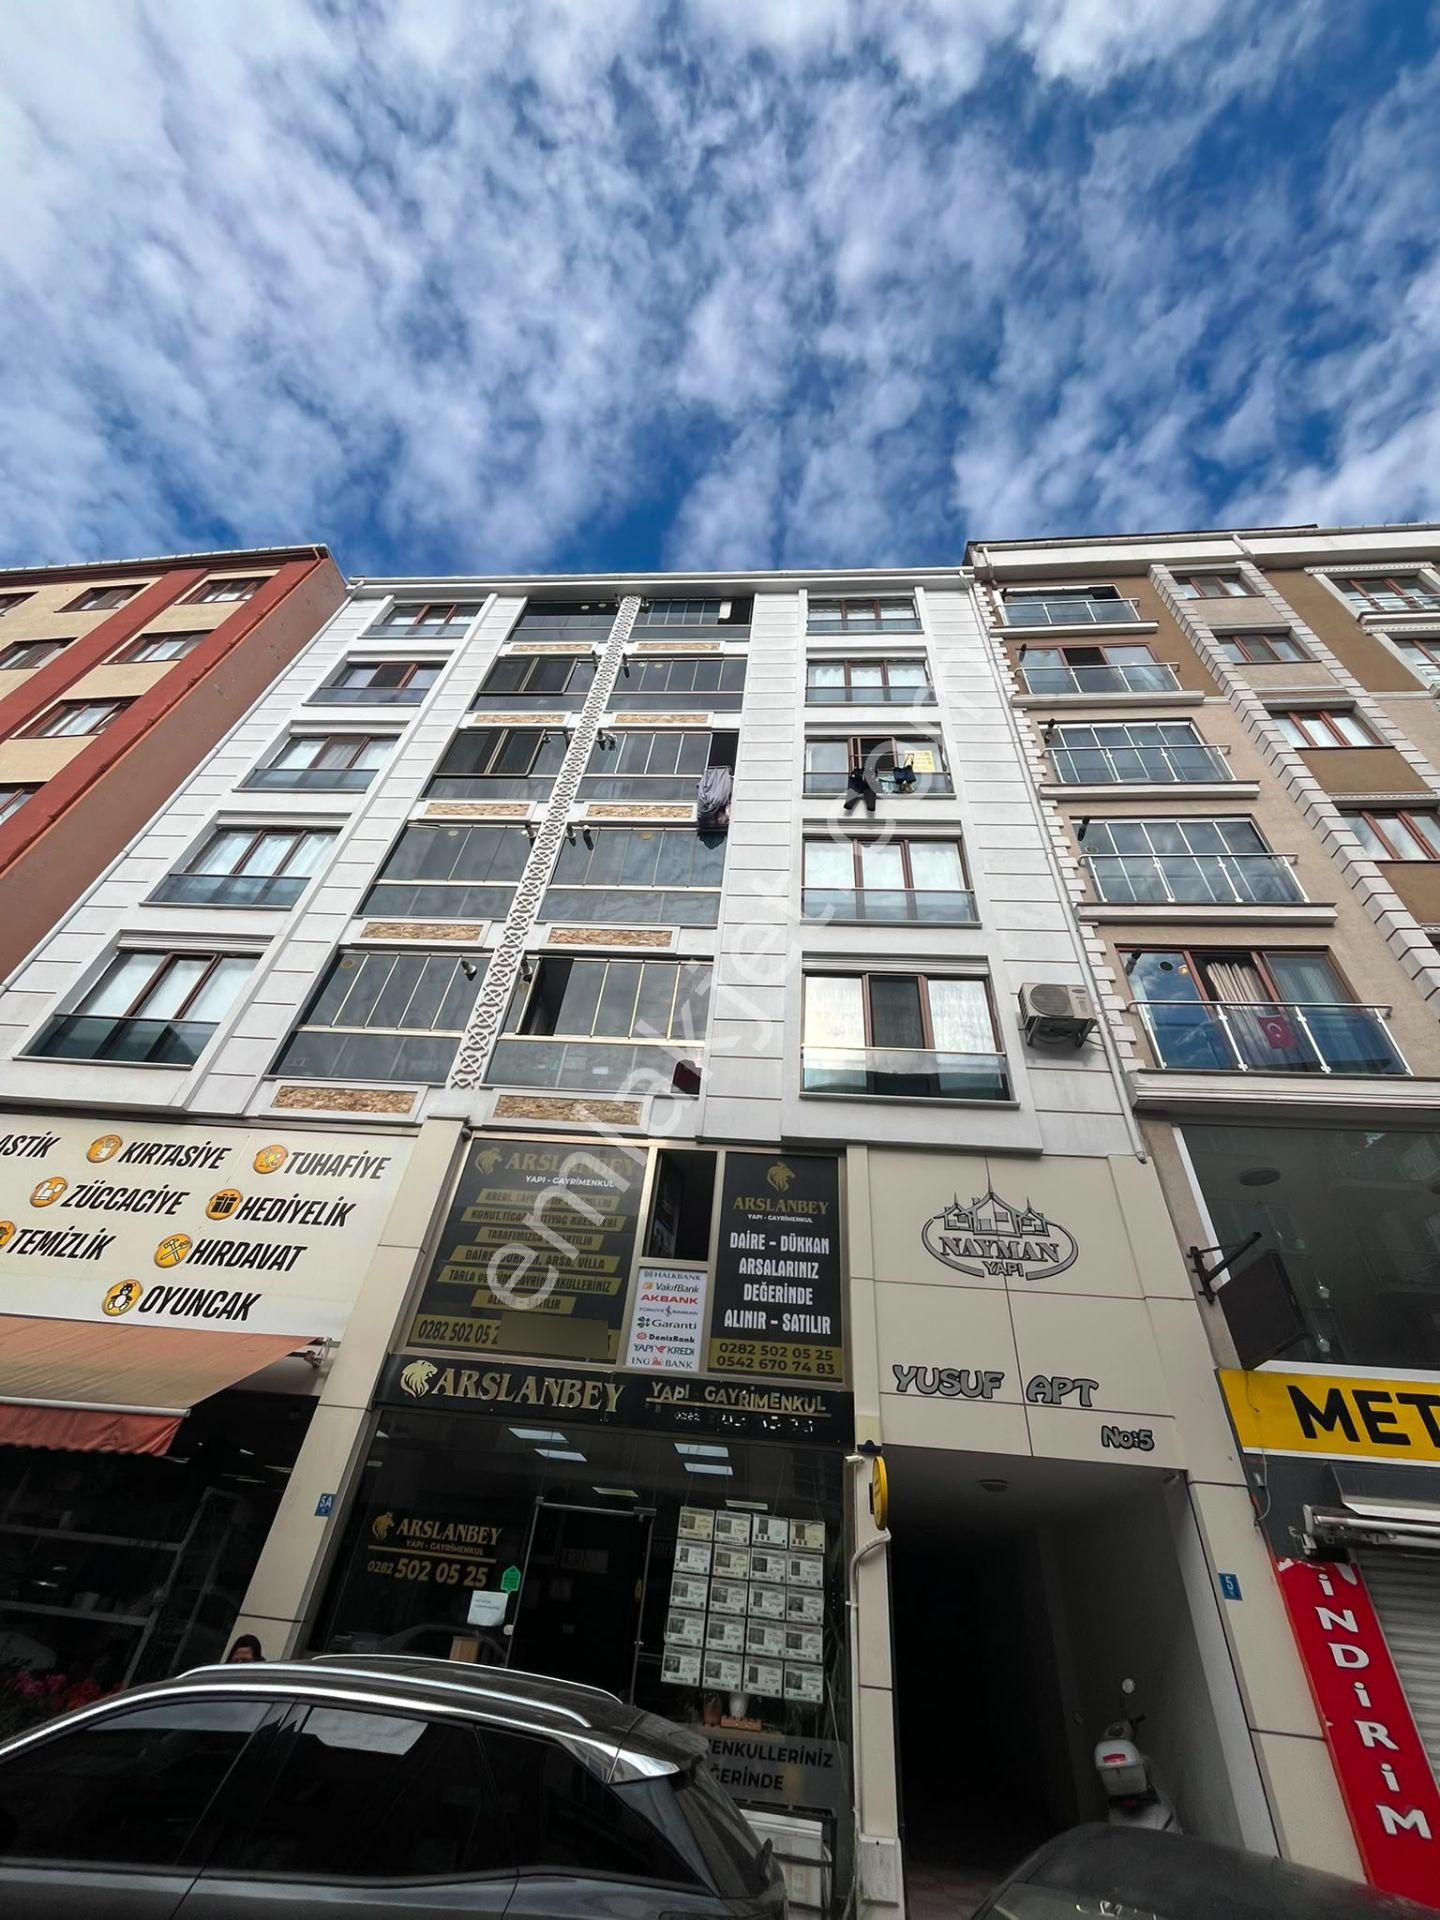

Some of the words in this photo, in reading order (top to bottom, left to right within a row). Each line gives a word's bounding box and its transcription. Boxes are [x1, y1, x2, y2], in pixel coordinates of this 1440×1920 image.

[117, 1141, 232, 1170] KIRTASİYE
[284, 1150, 392, 1181] TUHAFİYE
[505, 1152, 636, 1177] ARSLEY
[525, 1175, 546, 1183] YAPI
[60, 1180, 190, 1215] ZÜCCACİYE
[733, 1197, 830, 1215] ARSLANBEY
[235, 1194, 357, 1227] HEDİYELİK
[7, 1226, 116, 1261] TEMİZLİK
[729, 1230, 766, 1250] DAİRE
[780, 1233, 830, 1254] DÜKKAN
[939, 1235, 1060, 1263] NAYMAN
[185, 1239, 307, 1272] HIRDAVAT
[739, 1257, 819, 1279] ARSALARINIZ
[654, 1271, 701, 1281] HALKBANK
[983, 1259, 1024, 1278] YAPI
[640, 1294, 699, 1304] AKBANK
[656, 1283, 700, 1293] VakıfBank
[743, 1281, 814, 1306] DEĞERİNDE
[138, 1285, 263, 1321] OYUNCAK
[418, 1320, 449, 1341] 0282
[448, 1321, 473, 1343] 502
[475, 1325, 493, 1344] 05
[651, 1320, 697, 1330] Garanti
[724, 1309, 766, 1330] ALINIR
[782, 1313, 831, 1335] SATILIR
[633, 1344, 654, 1352] YAPI
[649, 1333, 696, 1343] DenizBank
[631, 1357, 650, 1365] ING
[665, 1359, 693, 1369] BANK
[719, 1342, 756, 1355] 0282
[760, 1344, 788, 1357] 502
[792, 1347, 812, 1359] 05
[815, 1349, 833, 1361] 25
[716, 1355, 755, 1368] 0542
[759, 1358, 788, 1371] 670
[792, 1361, 812, 1373] 74
[816, 1362, 835, 1375] 83
[431, 1367, 626, 1413] ARSLANBEY
[651, 1382, 689, 1400] YAPI
[704, 1386, 827, 1413] GAYRİMENKUL
[892, 1364, 1005, 1399] YUSUF
[1026, 1374, 1099, 1408] APT
[1101, 1425, 1155, 1451] No:5
[320, 1495, 332, 1508] 5A
[396, 1517, 503, 1546] ARSLANBEY
[367, 1560, 394, 1575] 0282
[394, 1558, 433, 1582] 502
[435, 1562, 461, 1585] 05
[463, 1566, 489, 1588] 25
[1225, 1575, 1234, 1590] 5
[708, 1738, 834, 1769] ENKULLERİNİZ
